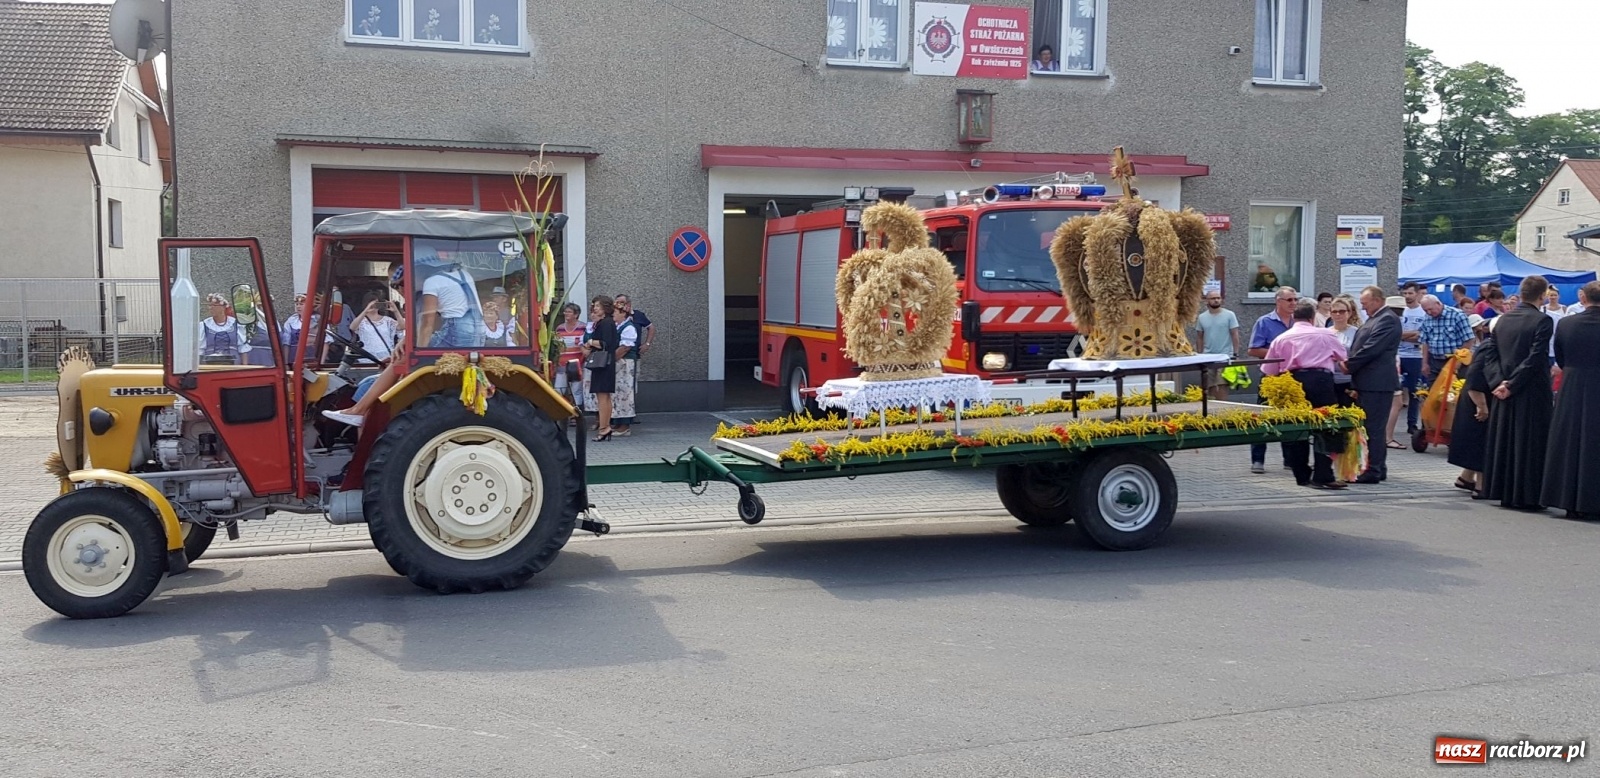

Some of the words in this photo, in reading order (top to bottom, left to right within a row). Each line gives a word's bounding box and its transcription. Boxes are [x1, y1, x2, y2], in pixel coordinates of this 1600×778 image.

[978, 17, 1018, 29] OCHOTNICZA
[970, 29, 992, 39] STRAŻ
[993, 30, 1025, 41] POŻARNA
[970, 45, 978, 53] w
[503, 241, 520, 253] PL
